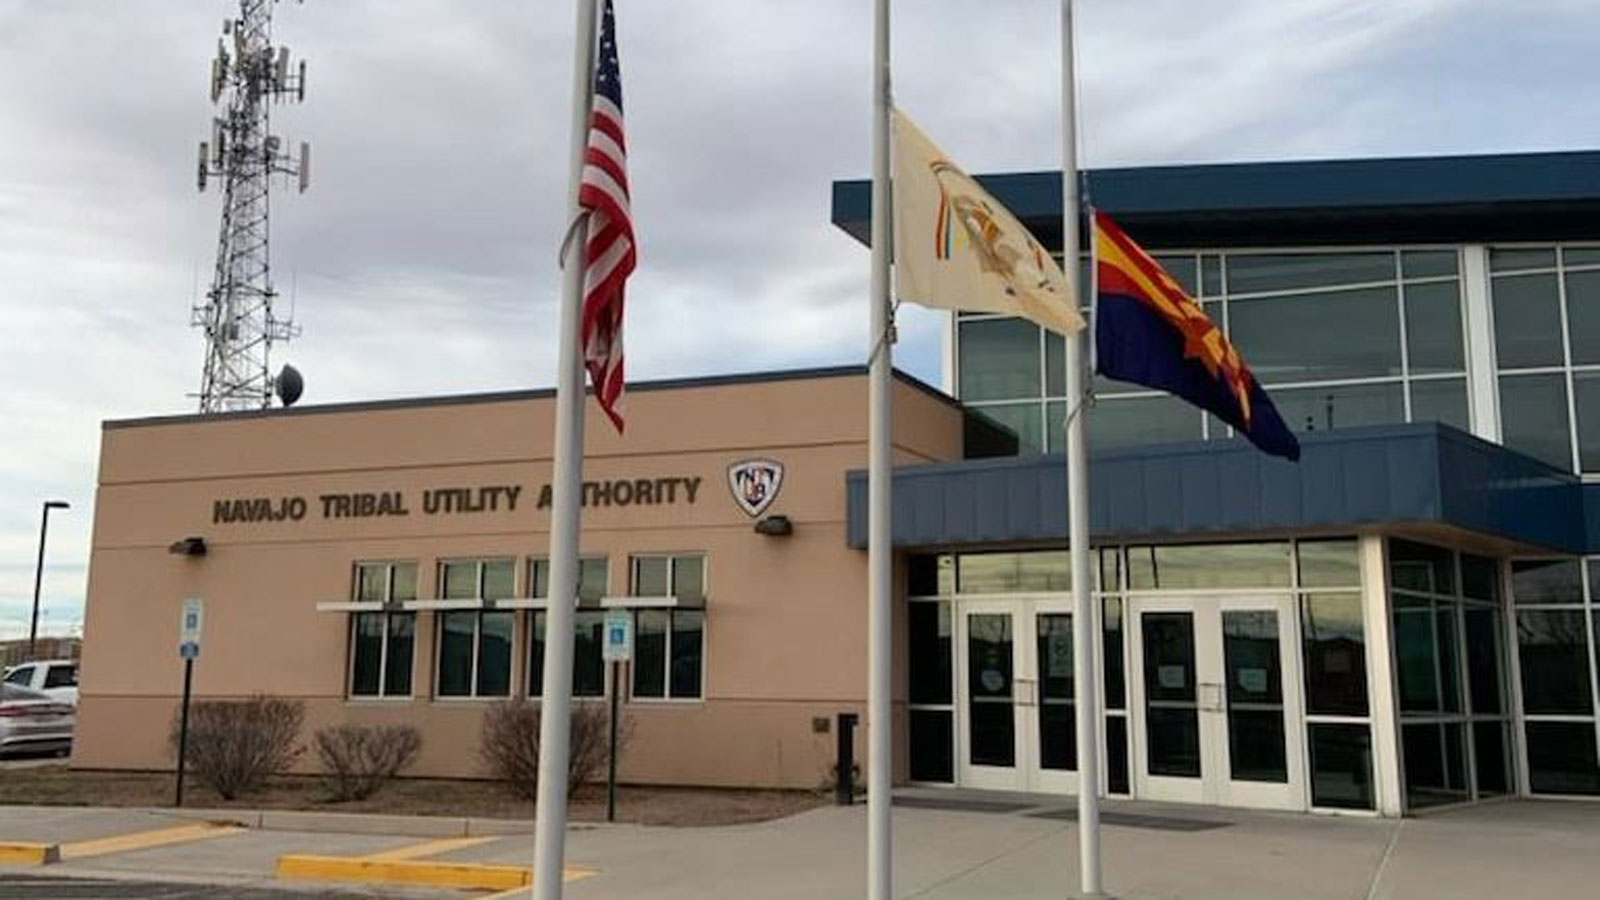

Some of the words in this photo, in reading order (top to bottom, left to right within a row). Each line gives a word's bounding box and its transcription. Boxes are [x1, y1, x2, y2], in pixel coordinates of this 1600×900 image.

[213, 496, 307, 524] NAVAJO
[319, 492, 409, 518] TRIBAL
[423, 486, 521, 514] UTILITY
[538, 477, 702, 509] ATHORITY
